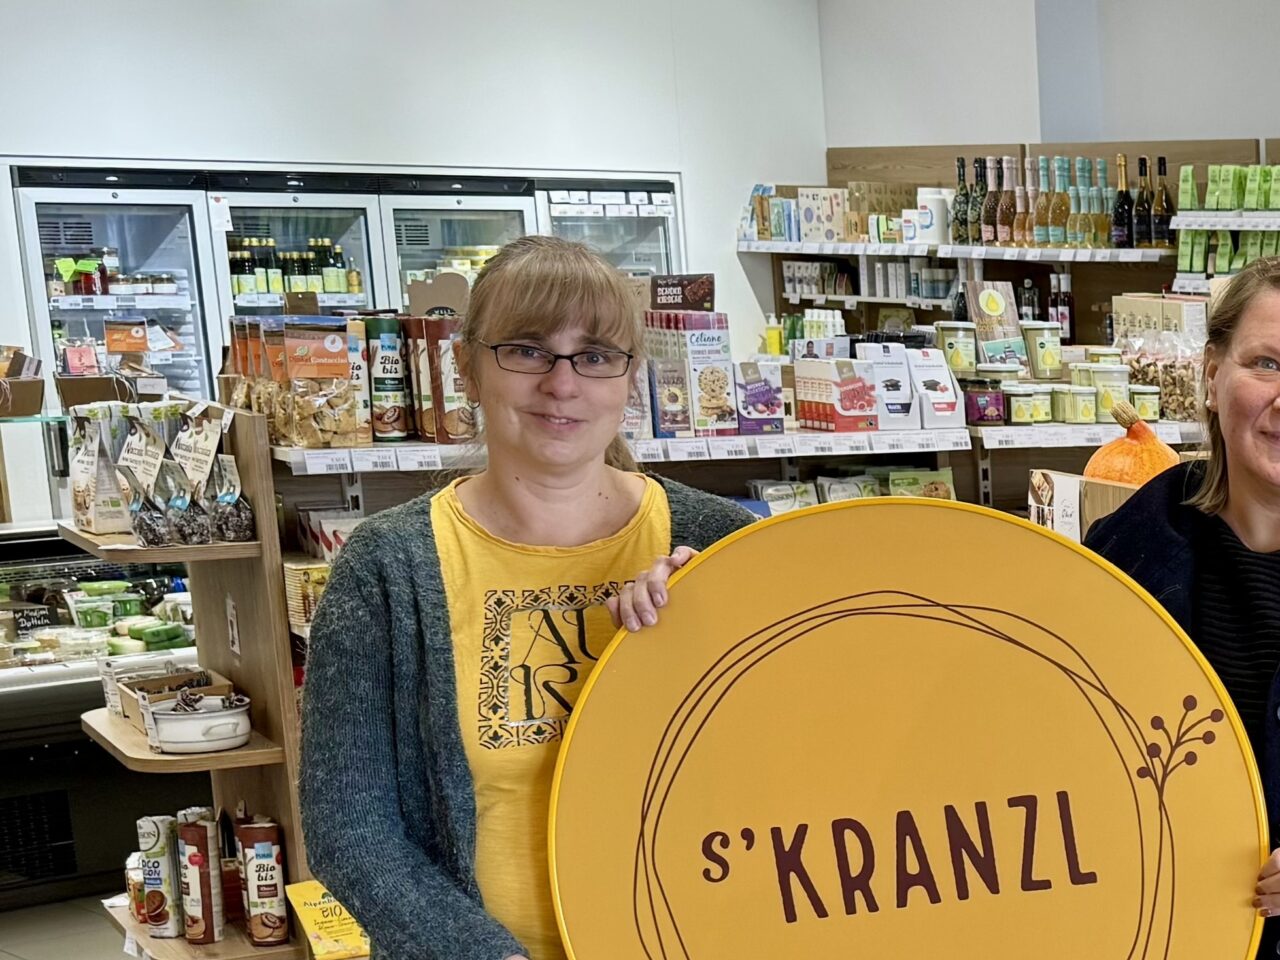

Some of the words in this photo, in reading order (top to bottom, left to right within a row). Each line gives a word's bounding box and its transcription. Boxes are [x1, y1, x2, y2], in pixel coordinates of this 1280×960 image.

[380, 356, 399, 365] Bio
[382, 366, 399, 375] bis
[255, 863, 276, 873] Bio
[257, 872, 275, 882] bis
